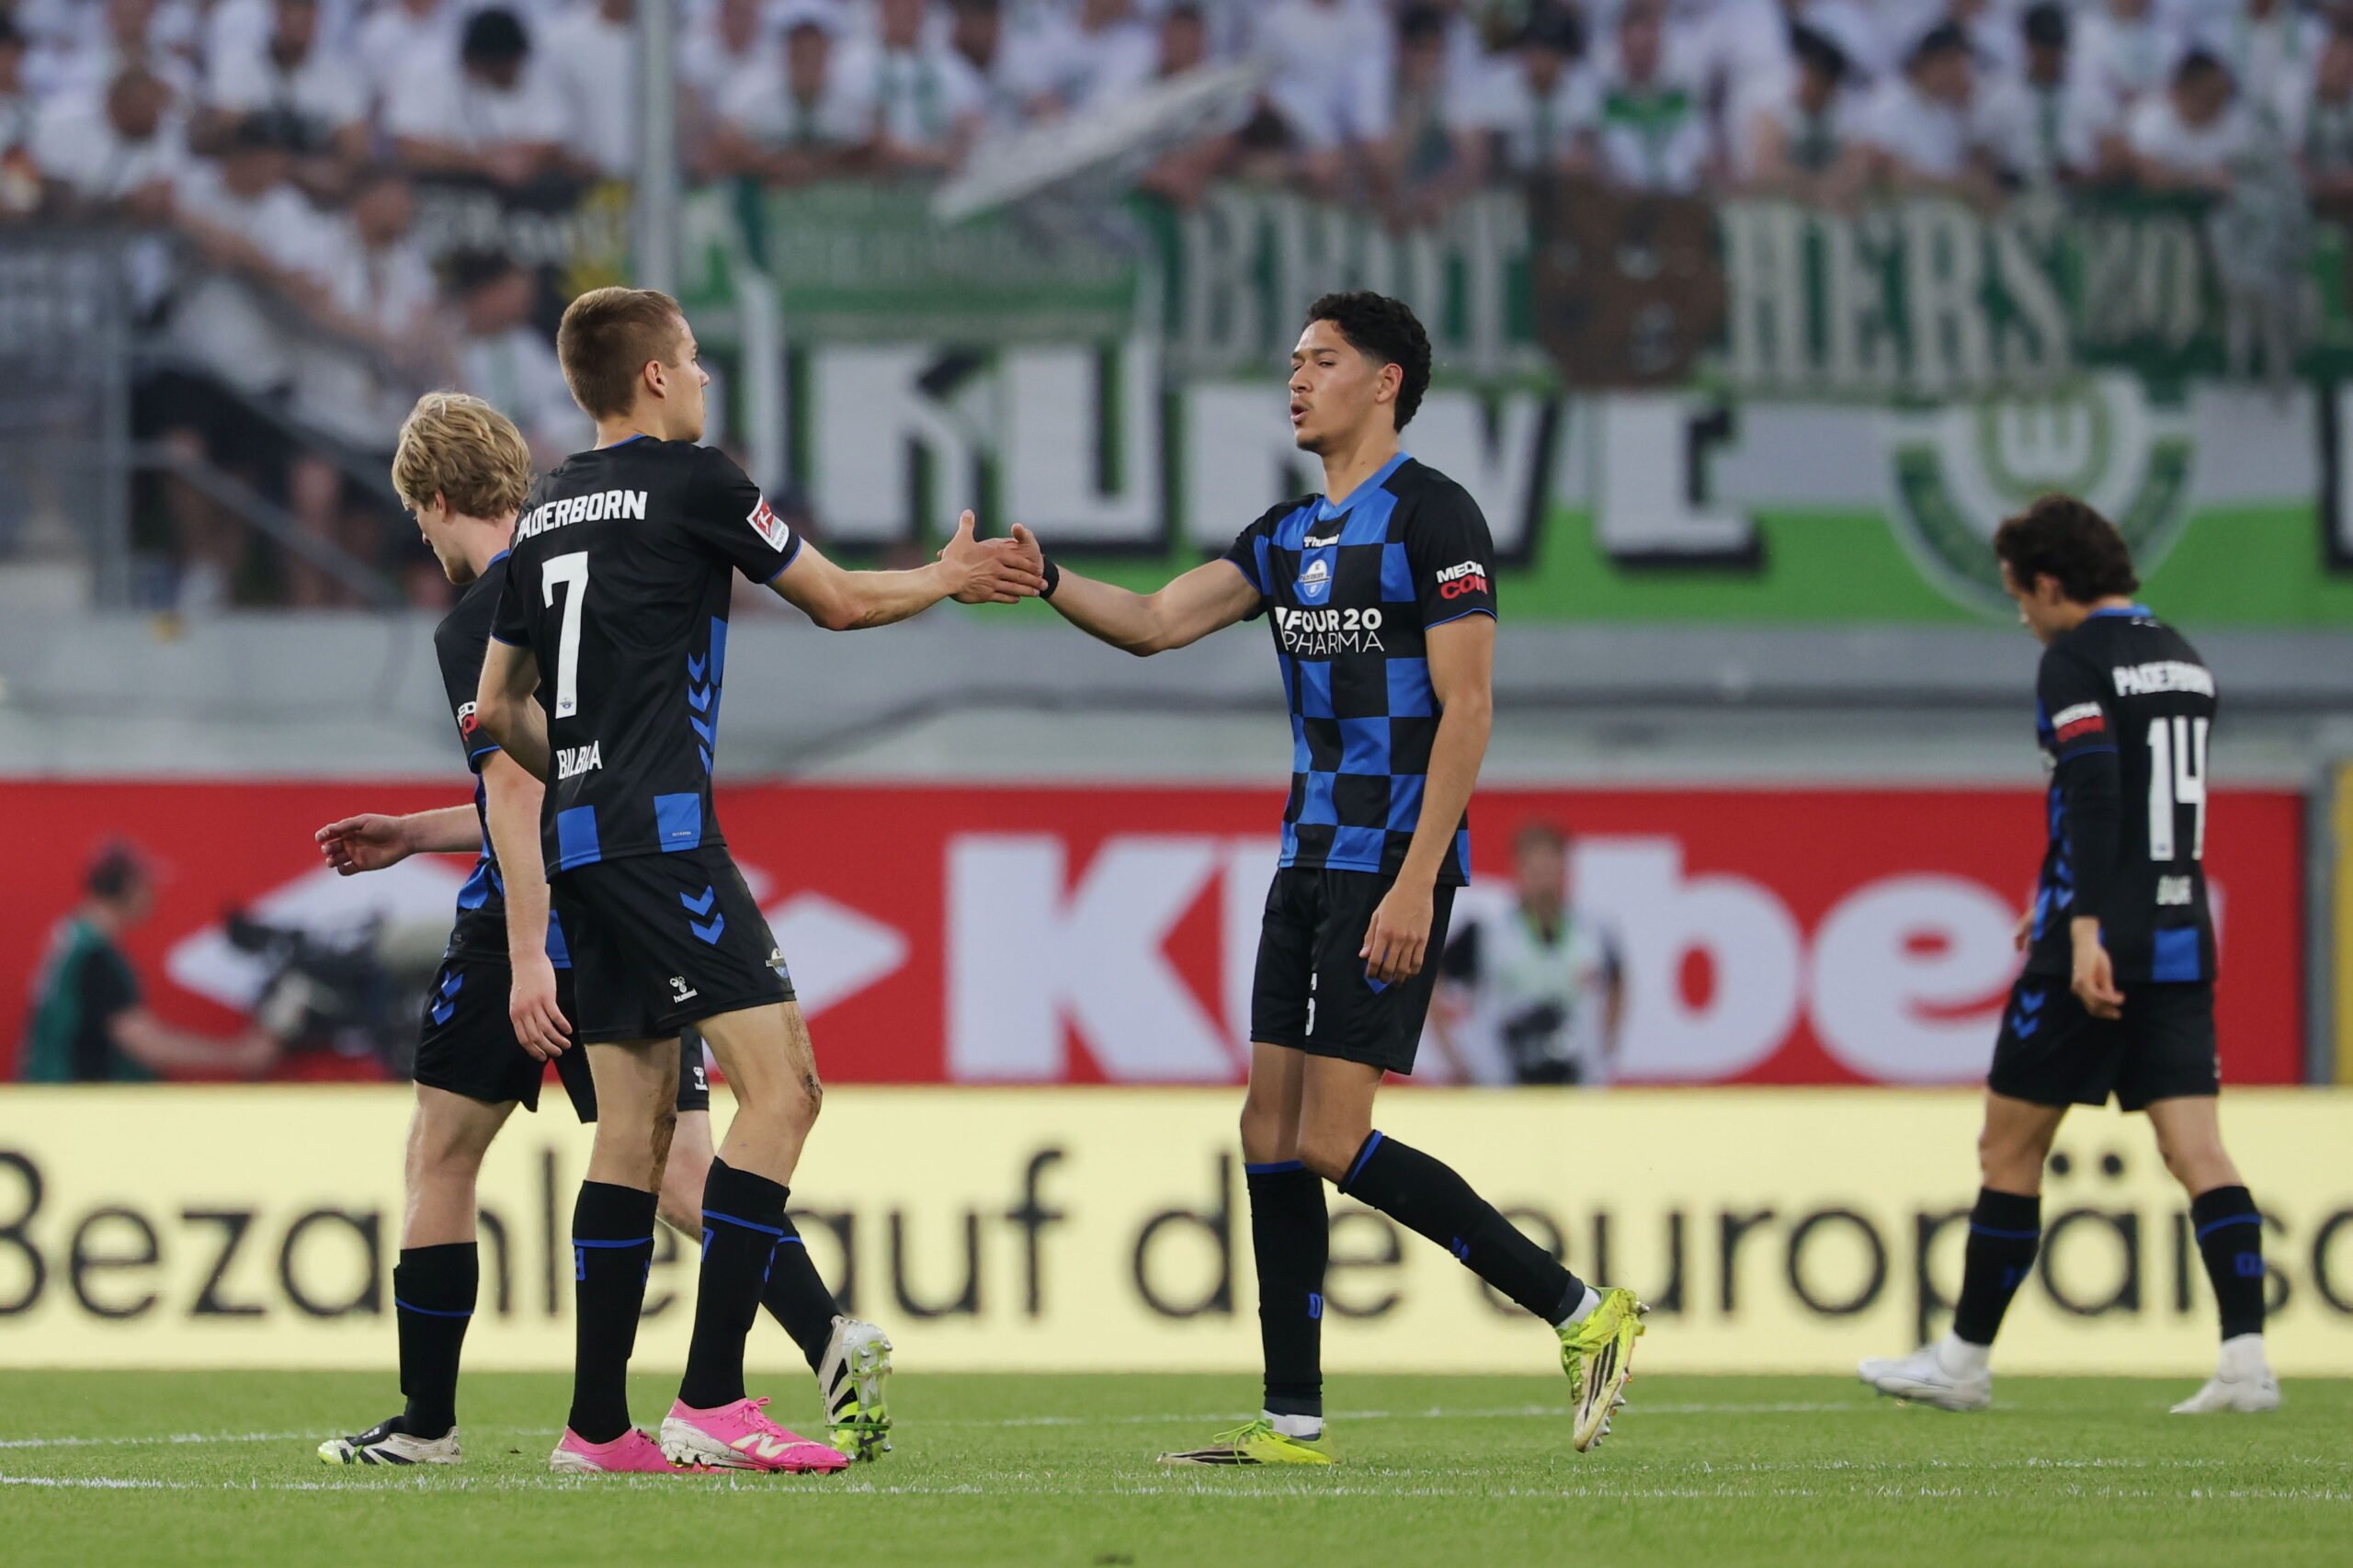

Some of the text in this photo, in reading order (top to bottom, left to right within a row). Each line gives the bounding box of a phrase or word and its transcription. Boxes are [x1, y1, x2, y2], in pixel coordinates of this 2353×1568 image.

[514, 490, 648, 548] PADERBORN
[541, 551, 589, 719] 7
[1284, 631, 1385, 655] PHARMA
[1285, 608, 1382, 633] FOUR 20
[2147, 715, 2210, 861] 14
[1134, 1154, 1403, 1318] de
